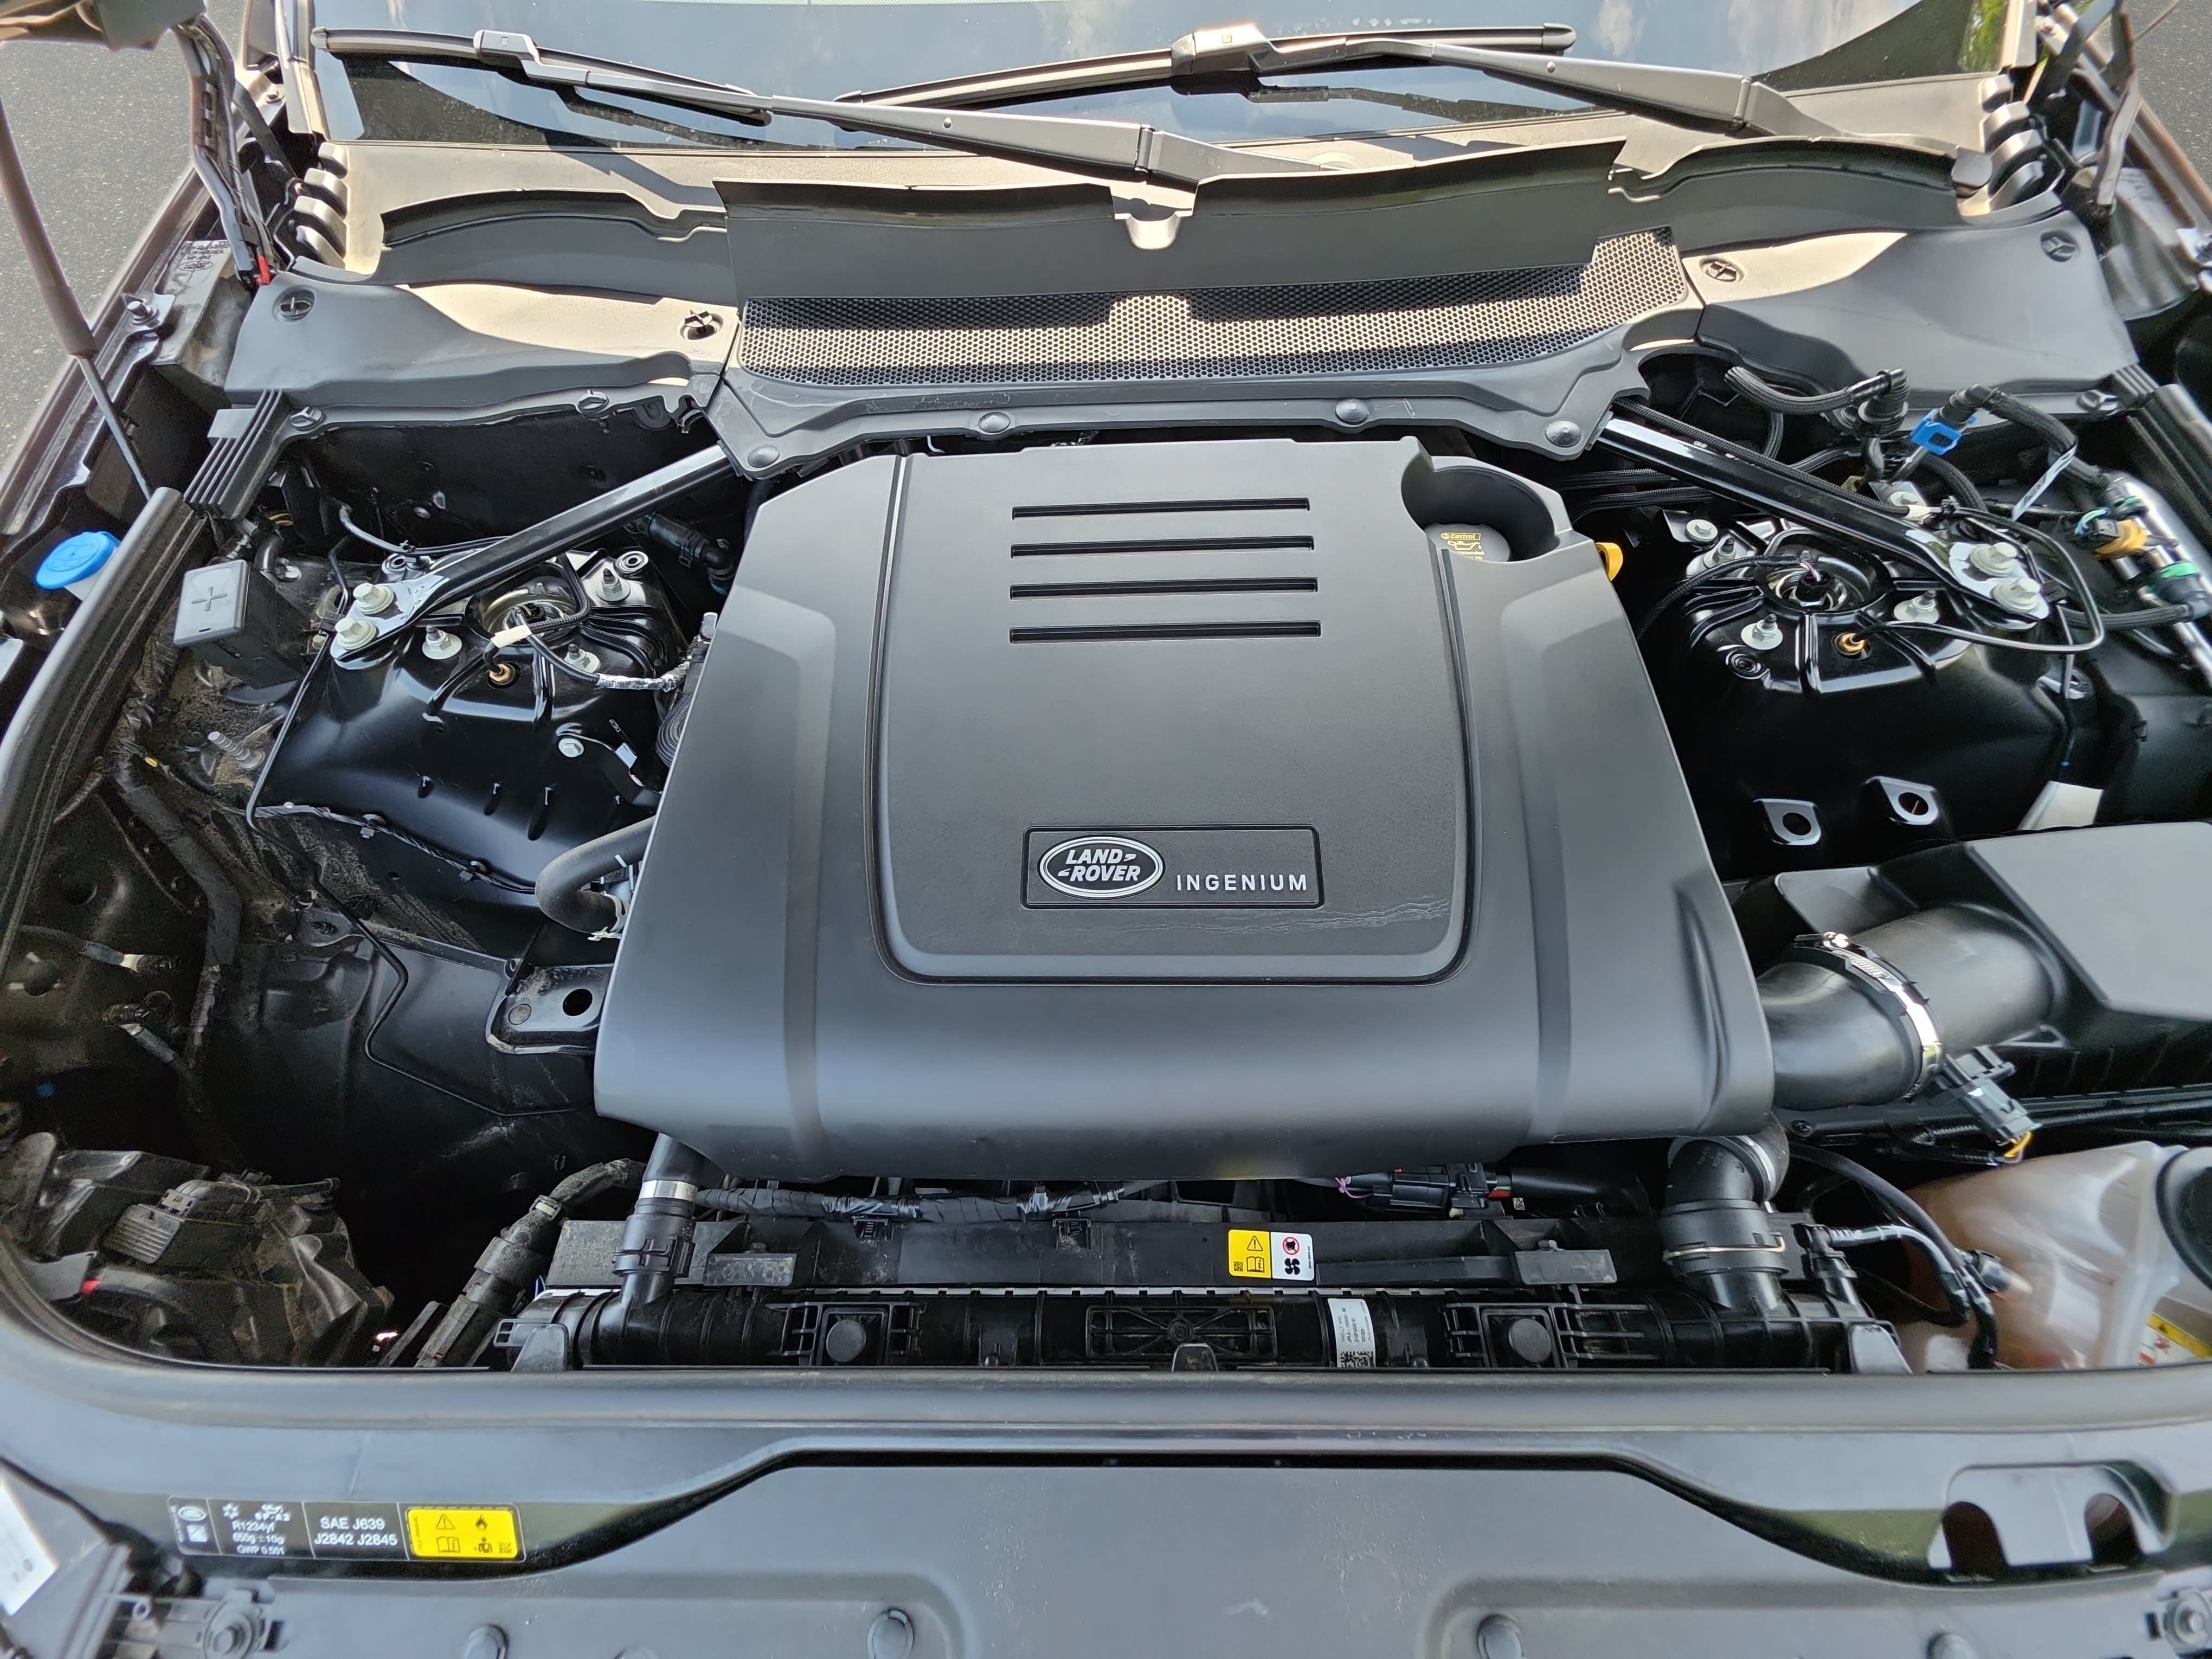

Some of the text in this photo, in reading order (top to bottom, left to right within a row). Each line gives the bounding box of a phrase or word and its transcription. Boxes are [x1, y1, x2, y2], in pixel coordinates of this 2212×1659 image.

[1065, 849, 1123, 864] LAND
[1070, 865, 1140, 881] ROVER
[1176, 874, 1307, 891] INGENIUM
[320, 1516, 385, 1531] SAE J639
[232, 1532, 256, 1545] 650g
[313, 1532, 398, 1546] J2842 J2845
